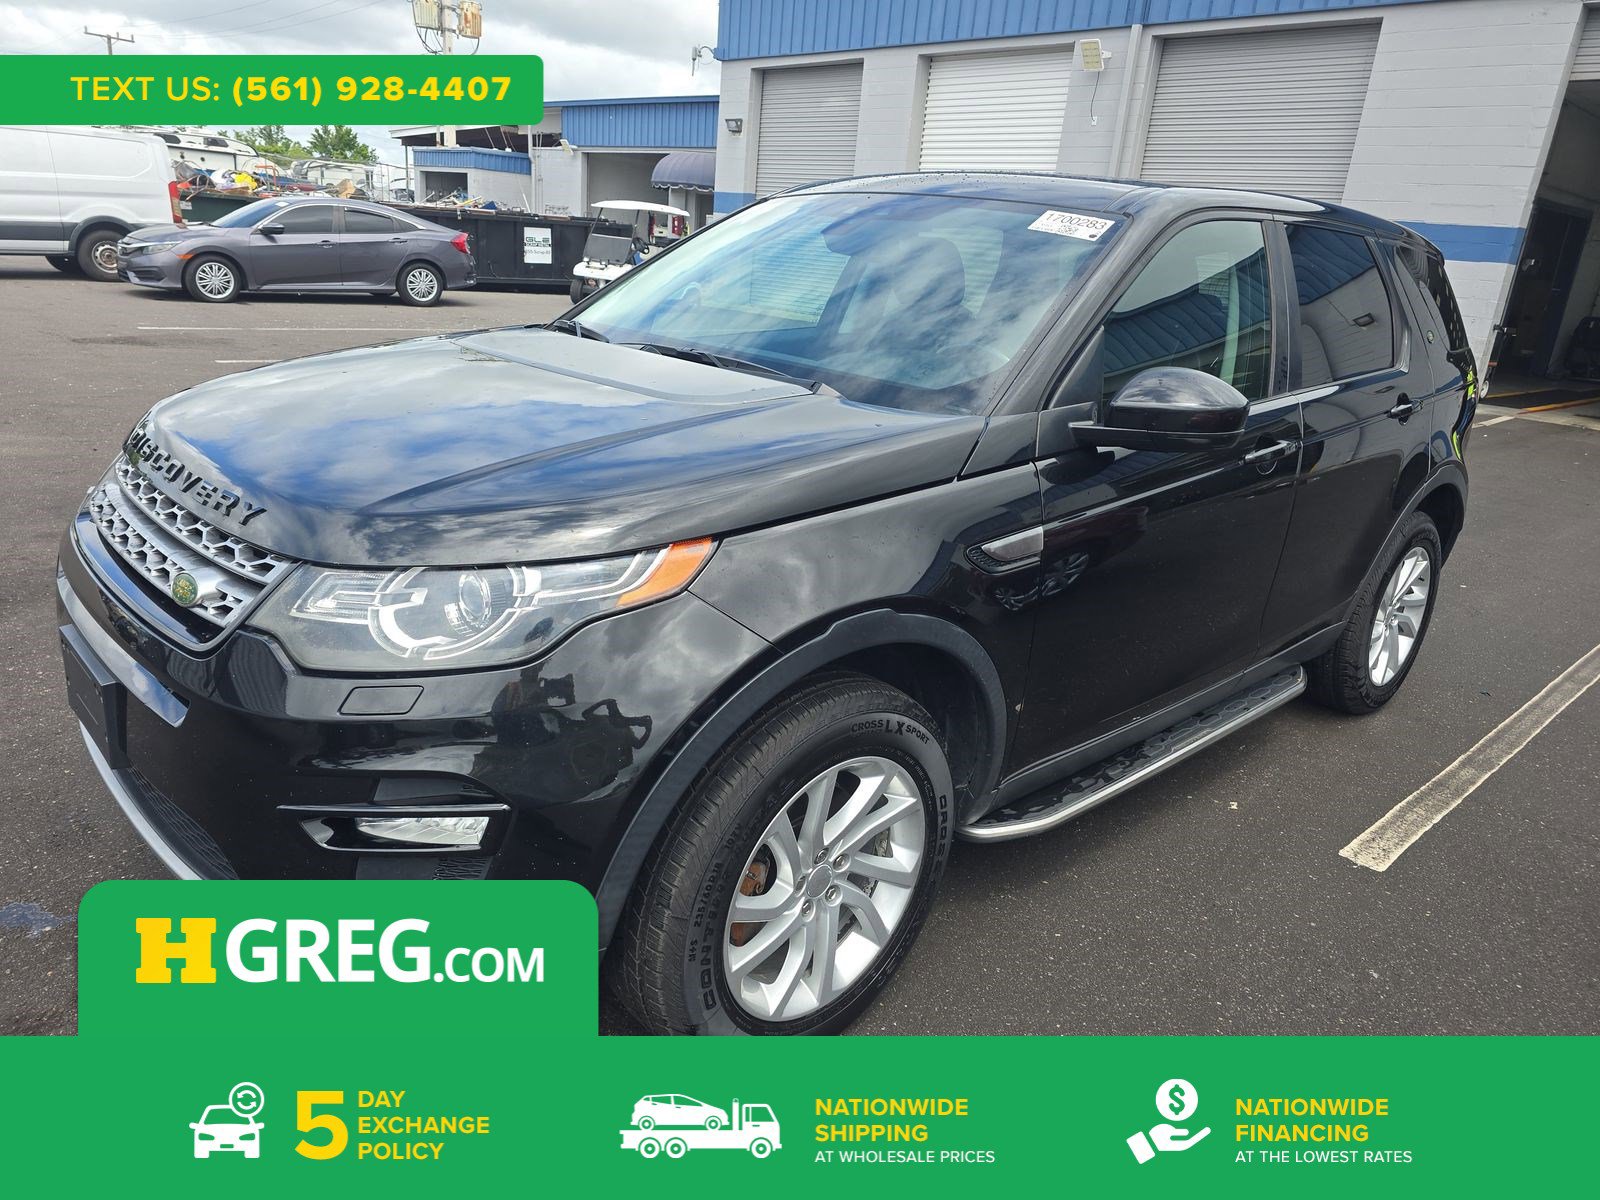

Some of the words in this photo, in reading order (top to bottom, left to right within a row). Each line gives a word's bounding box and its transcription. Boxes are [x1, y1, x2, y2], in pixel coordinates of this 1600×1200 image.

[1046, 213, 1107, 230] 1700283
[851, 719, 885, 733] CROSS
[905, 724, 930, 745] SPORT
